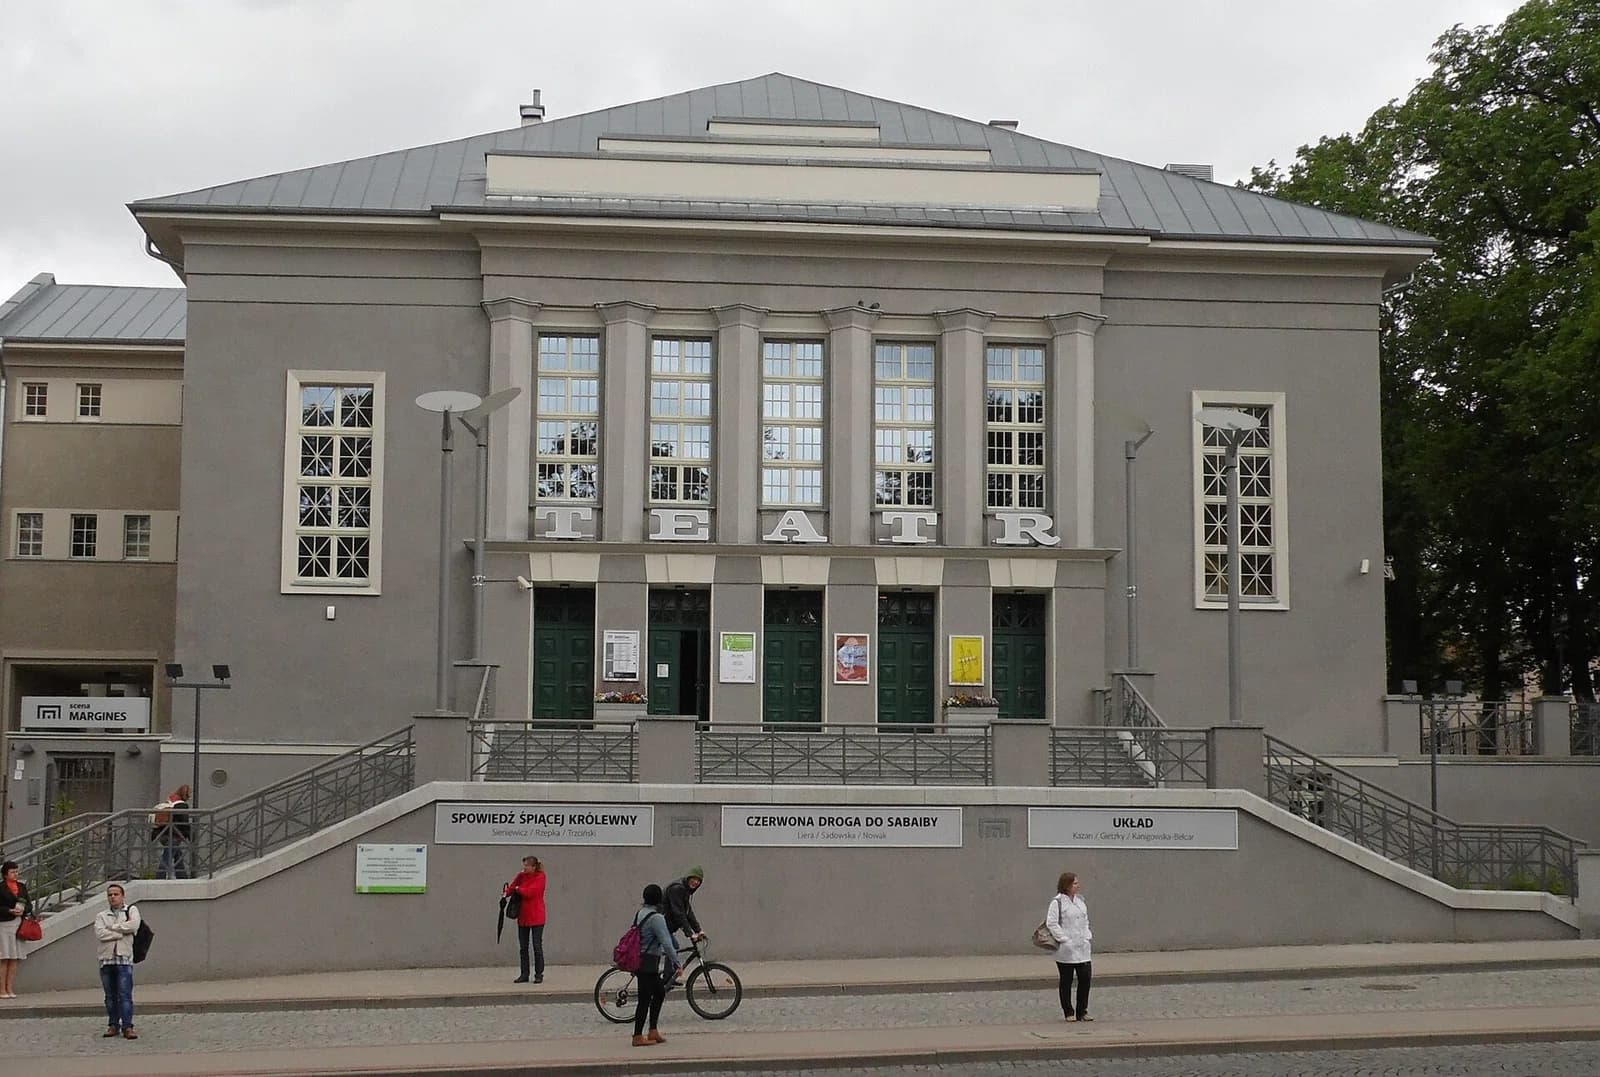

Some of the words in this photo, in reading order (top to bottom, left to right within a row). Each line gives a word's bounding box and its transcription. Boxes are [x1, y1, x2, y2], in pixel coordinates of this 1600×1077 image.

[535, 506, 1062, 547] TEATR
[69, 711, 127, 721] MARGINES
[451, 810, 515, 824] SPOWIEDŹ
[519, 810, 565, 828] ŚPIĄCEJ
[569, 811, 638, 826] KRÓLEWNY
[746, 816, 815, 827] CZERWONA
[819, 816, 861, 827] DROGA
[865, 816, 884, 827] DO
[887, 816, 938, 827] SABAIBY
[1112, 817, 1154, 828] UKŁAD
[863, 832, 886, 840] Nowak
